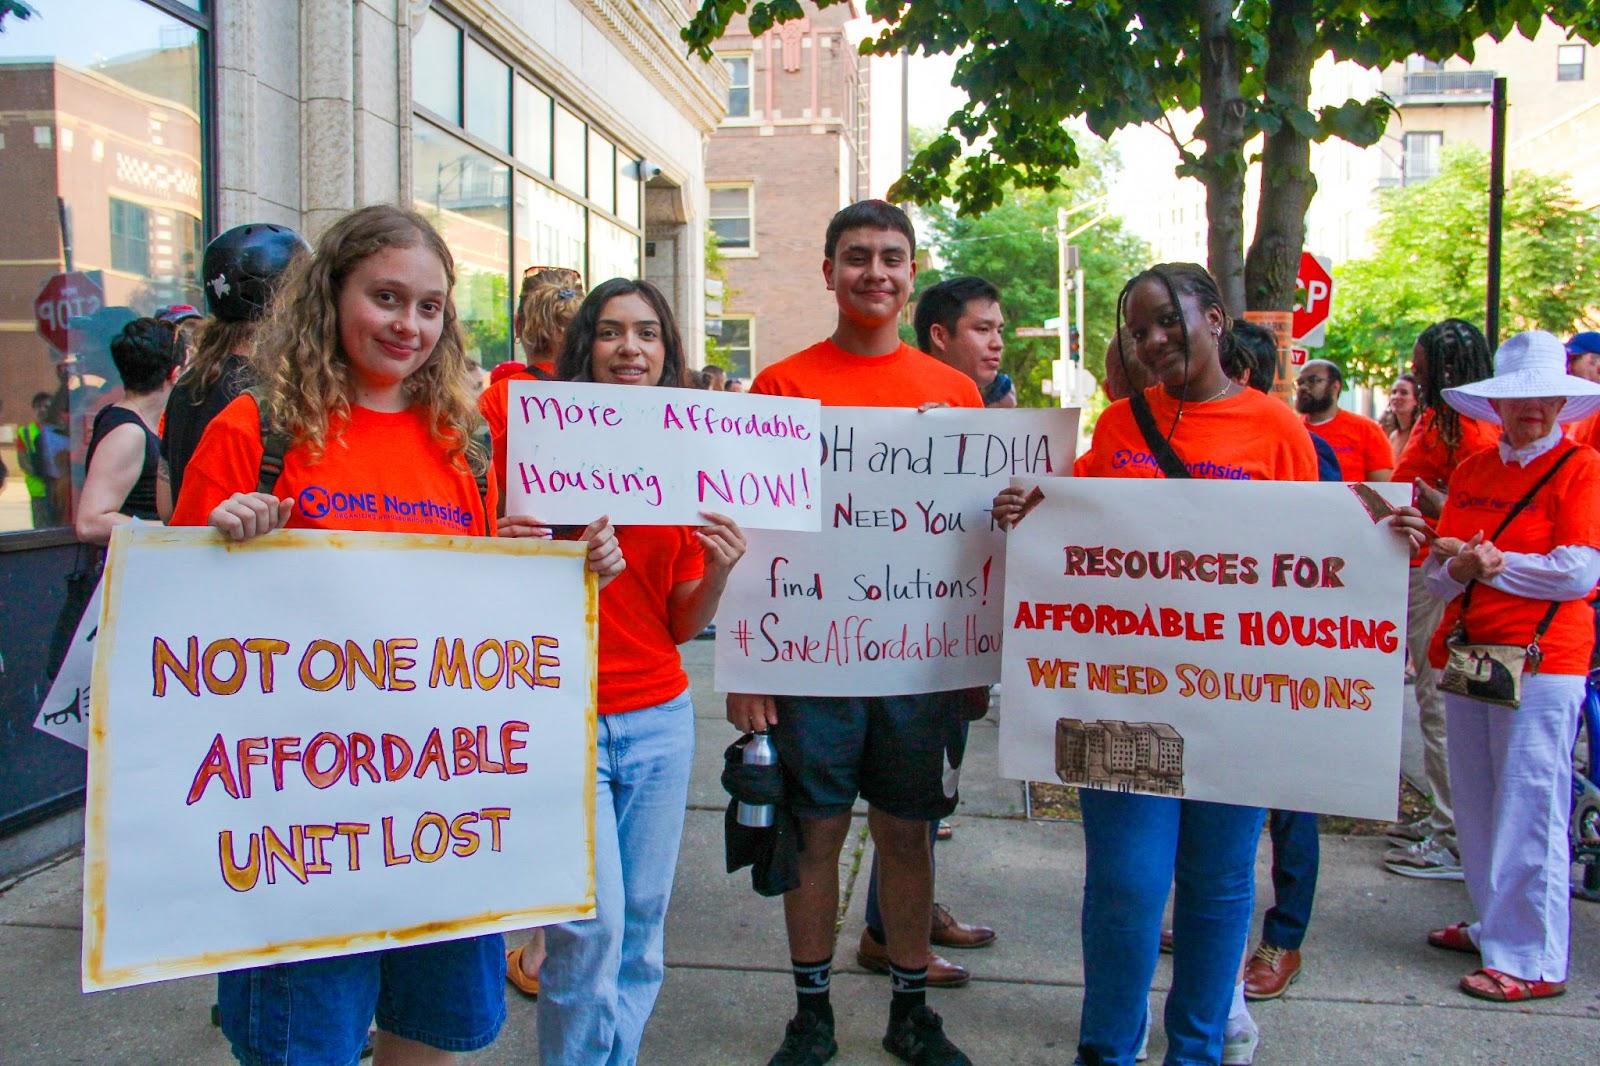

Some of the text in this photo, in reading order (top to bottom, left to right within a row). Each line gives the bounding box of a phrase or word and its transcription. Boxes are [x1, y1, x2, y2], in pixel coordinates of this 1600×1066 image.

[519, 395, 811, 441] More Affordable
[868, 437, 933, 475] and
[943, 433, 1054, 477] IDHA
[1132, 452, 1158, 467] ON
[332, 492, 378, 513] ONE
[384, 495, 473, 527] Northside
[518, 462, 813, 510] Housing NOW!
[833, 493, 907, 532] NEED
[766, 557, 823, 600] find
[1063, 545, 1345, 588] RESOURCES FOR
[730, 612, 1003, 666] #SaveAffordableHou
[1013, 601, 1399, 654] AFFORDABLE HOUSING
[152, 635, 561, 698] NOT ONE MORE
[1026, 657, 1375, 712] WE NEED SOLUTIONS
[186, 720, 530, 806] AFFORDABLE
[218, 807, 511, 893] UNIT LOST
